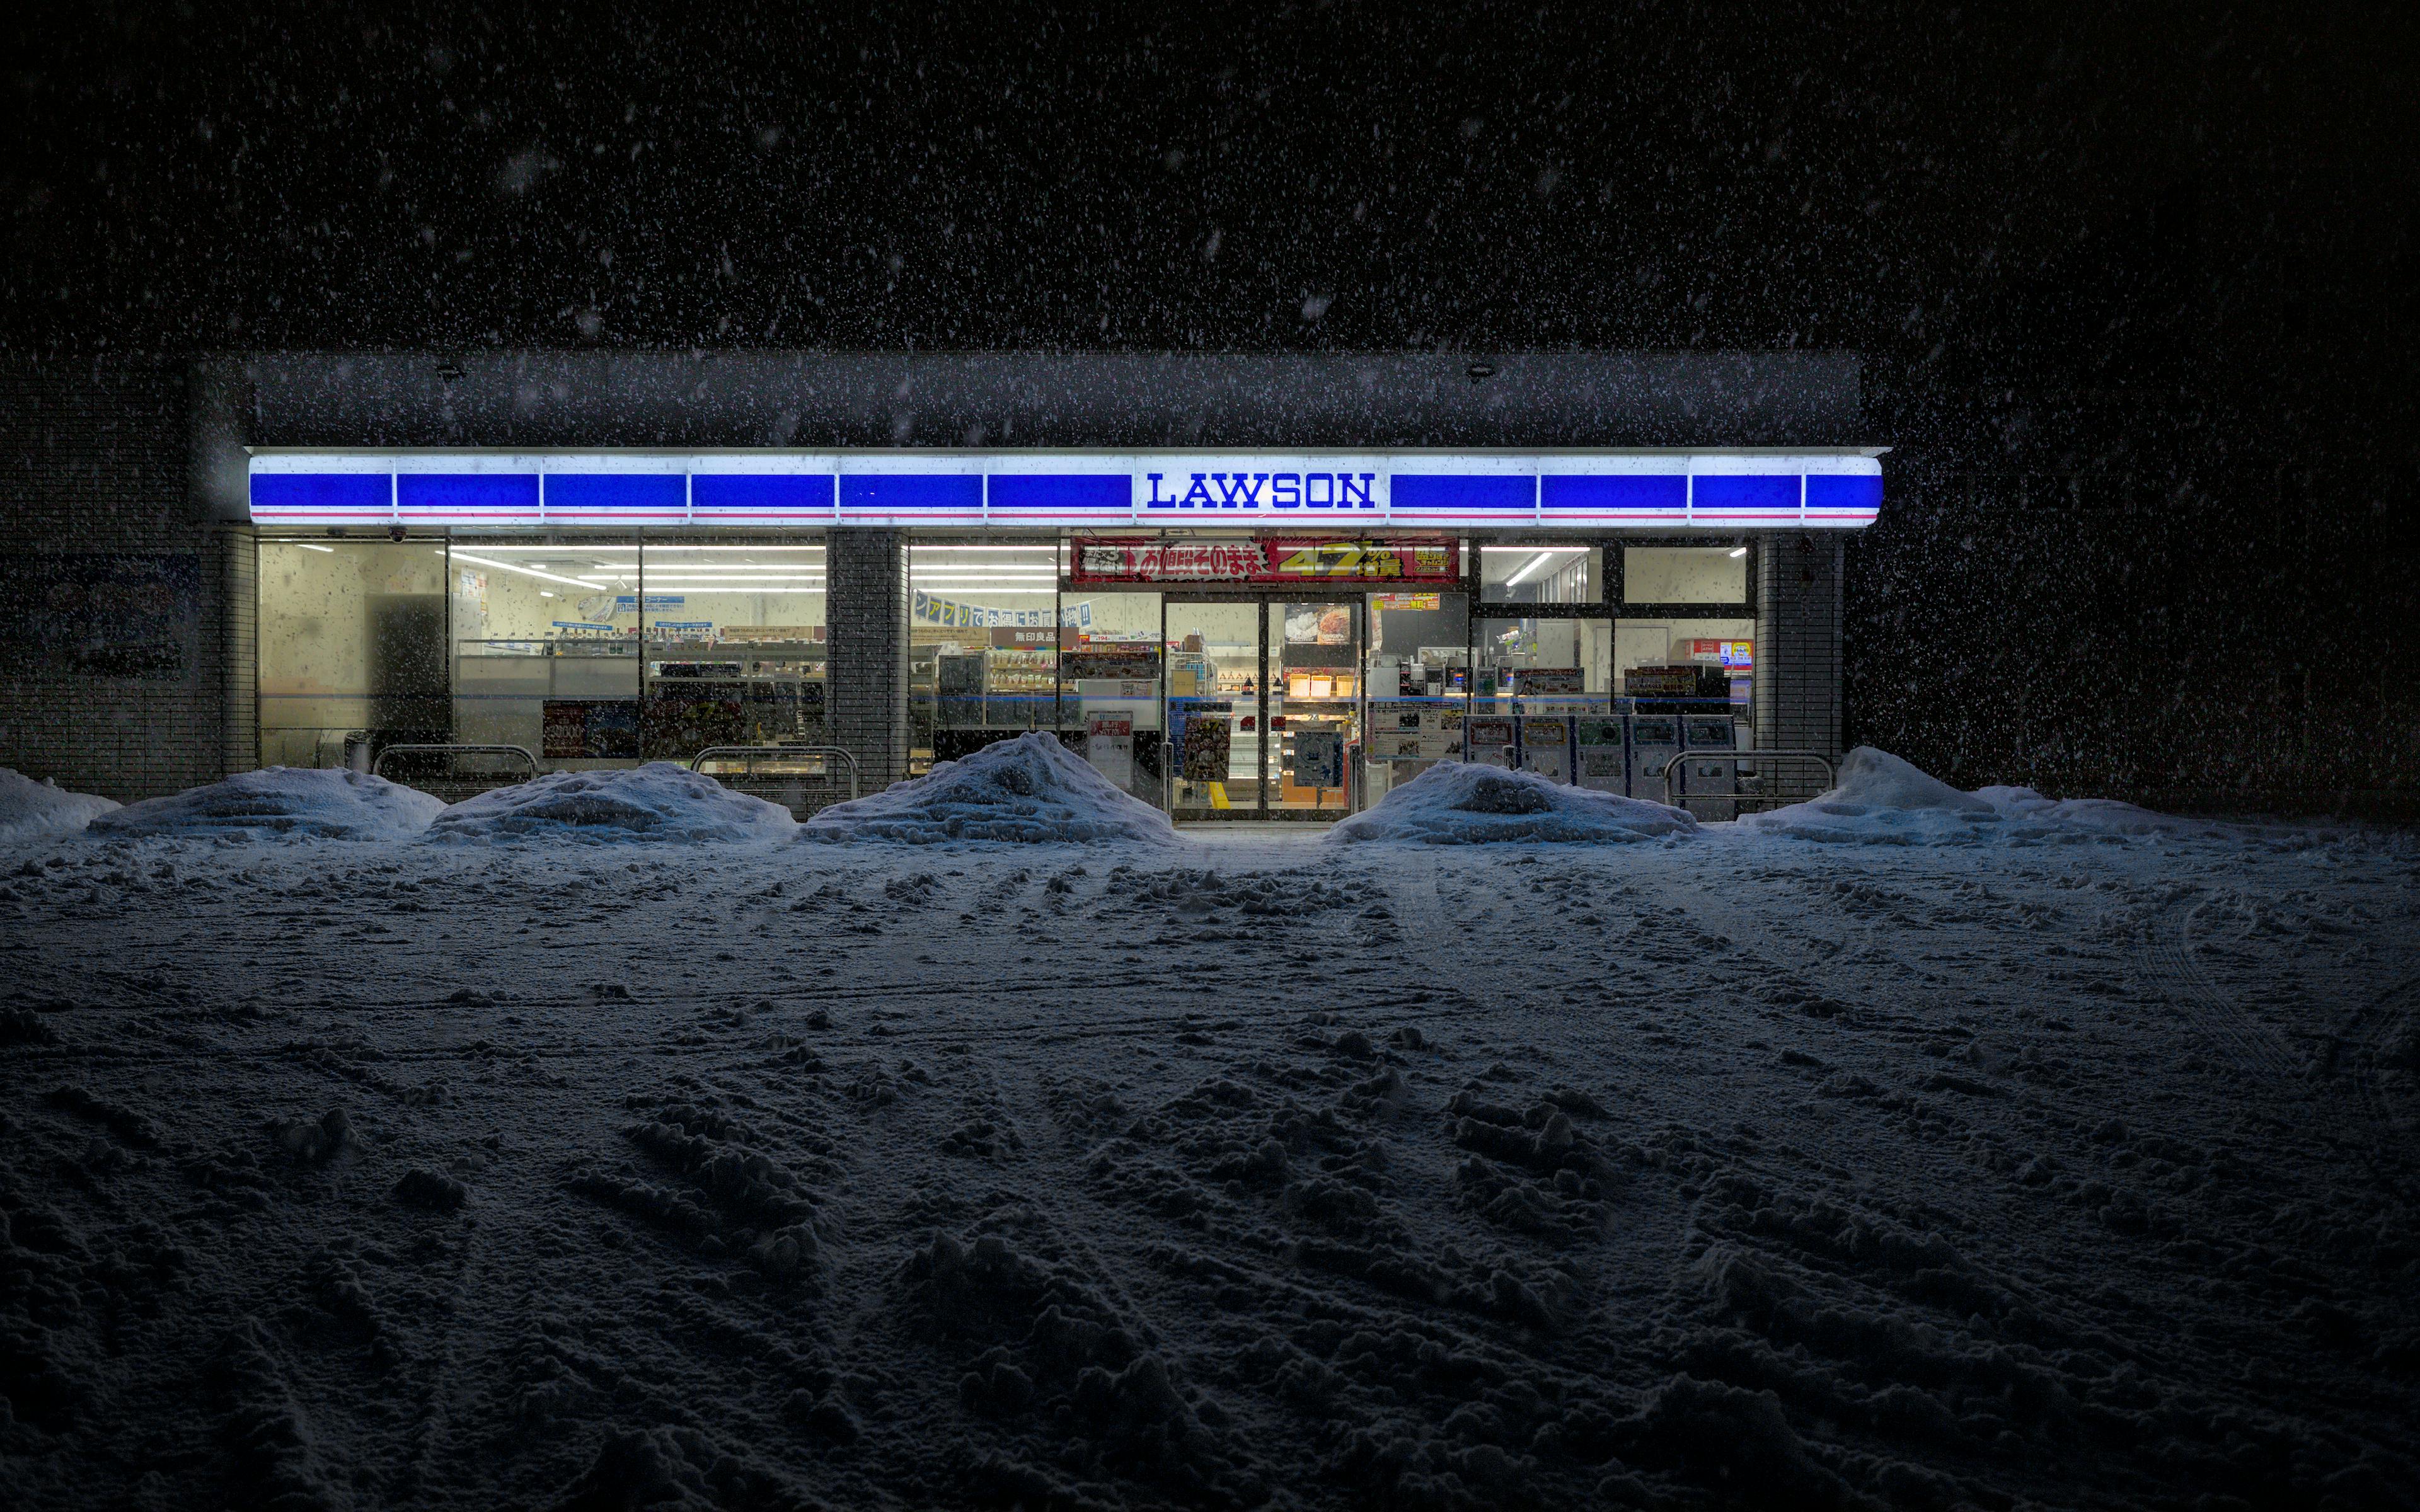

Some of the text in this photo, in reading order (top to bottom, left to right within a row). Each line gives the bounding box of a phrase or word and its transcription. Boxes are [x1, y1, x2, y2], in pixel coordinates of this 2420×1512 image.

[1147, 473, 1375, 508] LAWSON
[1139, 545, 1262, 575] お値段そのまま
[1357, 558, 1402, 576] 増量
[1015, 631, 1056, 642] 無印良品
